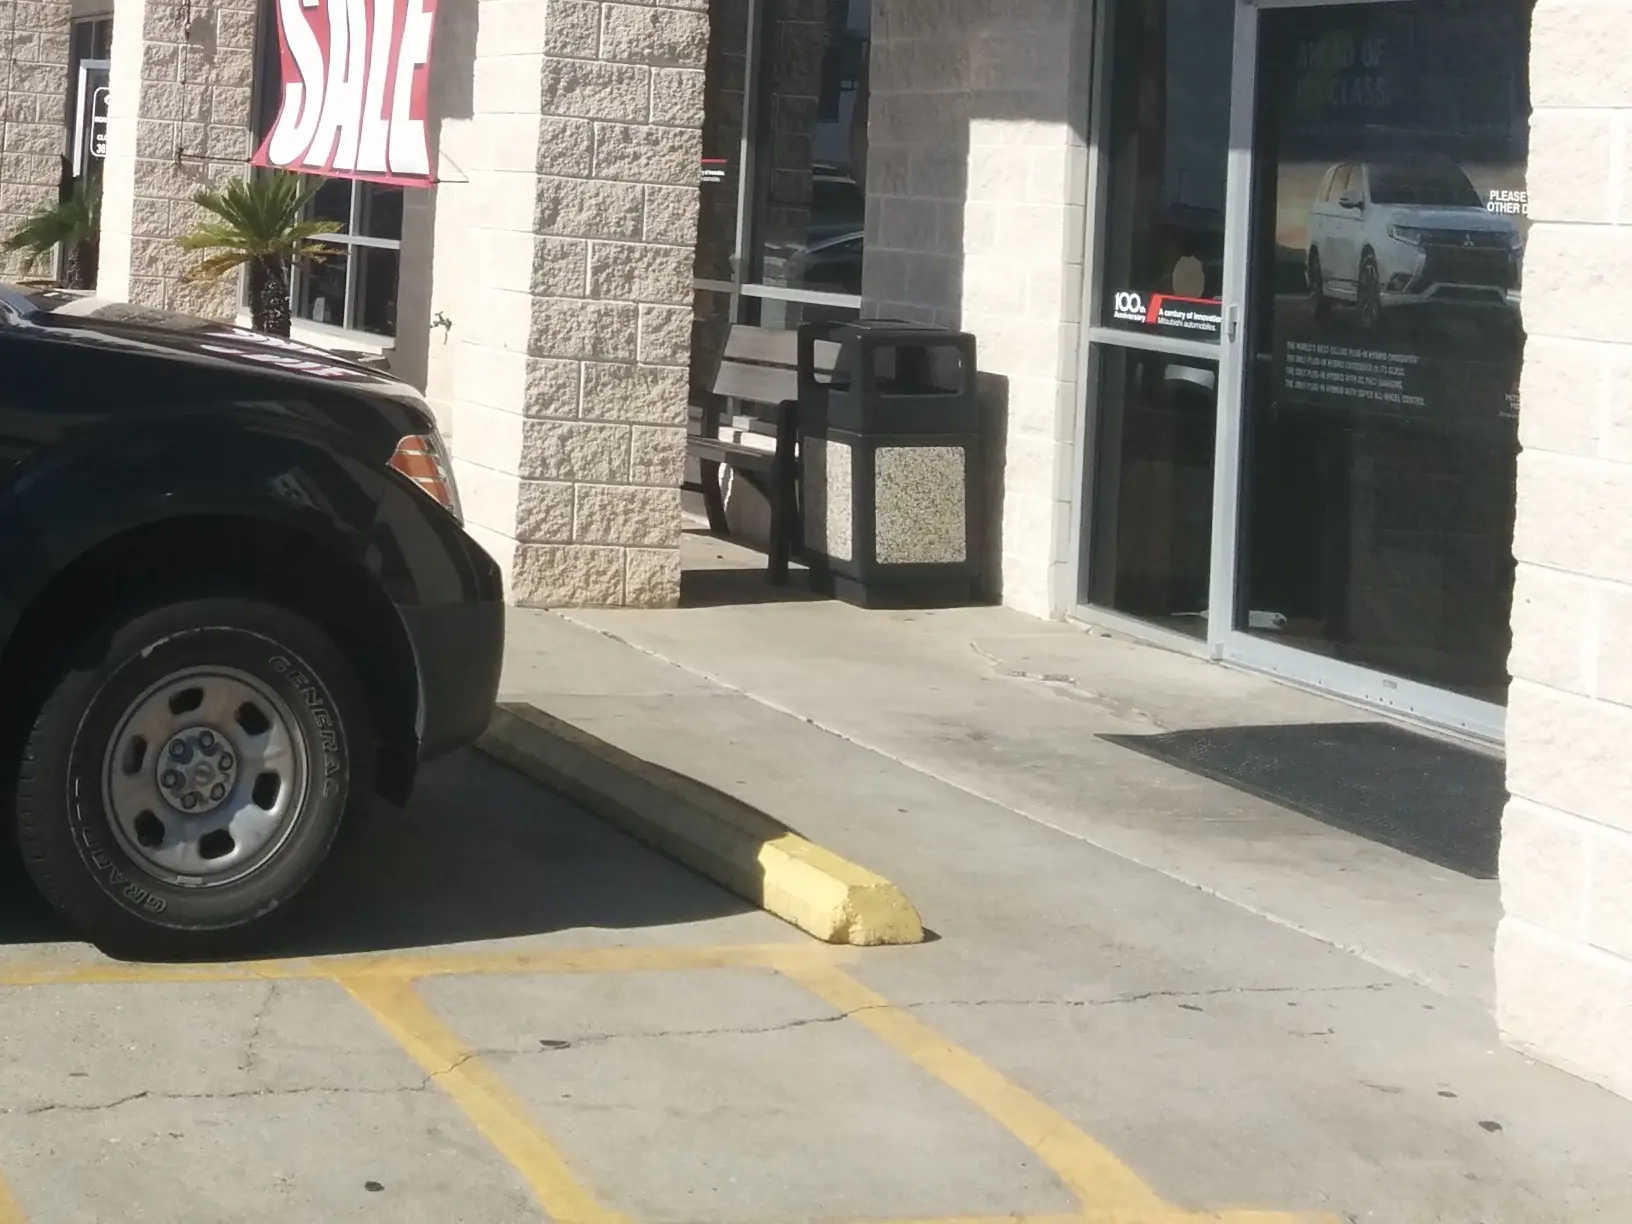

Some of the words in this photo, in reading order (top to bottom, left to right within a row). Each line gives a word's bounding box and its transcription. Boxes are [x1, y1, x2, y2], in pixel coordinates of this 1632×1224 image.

[1486, 201, 1521, 214] OTHER
[1489, 189, 1527, 203] PLEASE
[269, 655, 341, 799] GENERAL
[75, 776, 167, 914] GRAB
